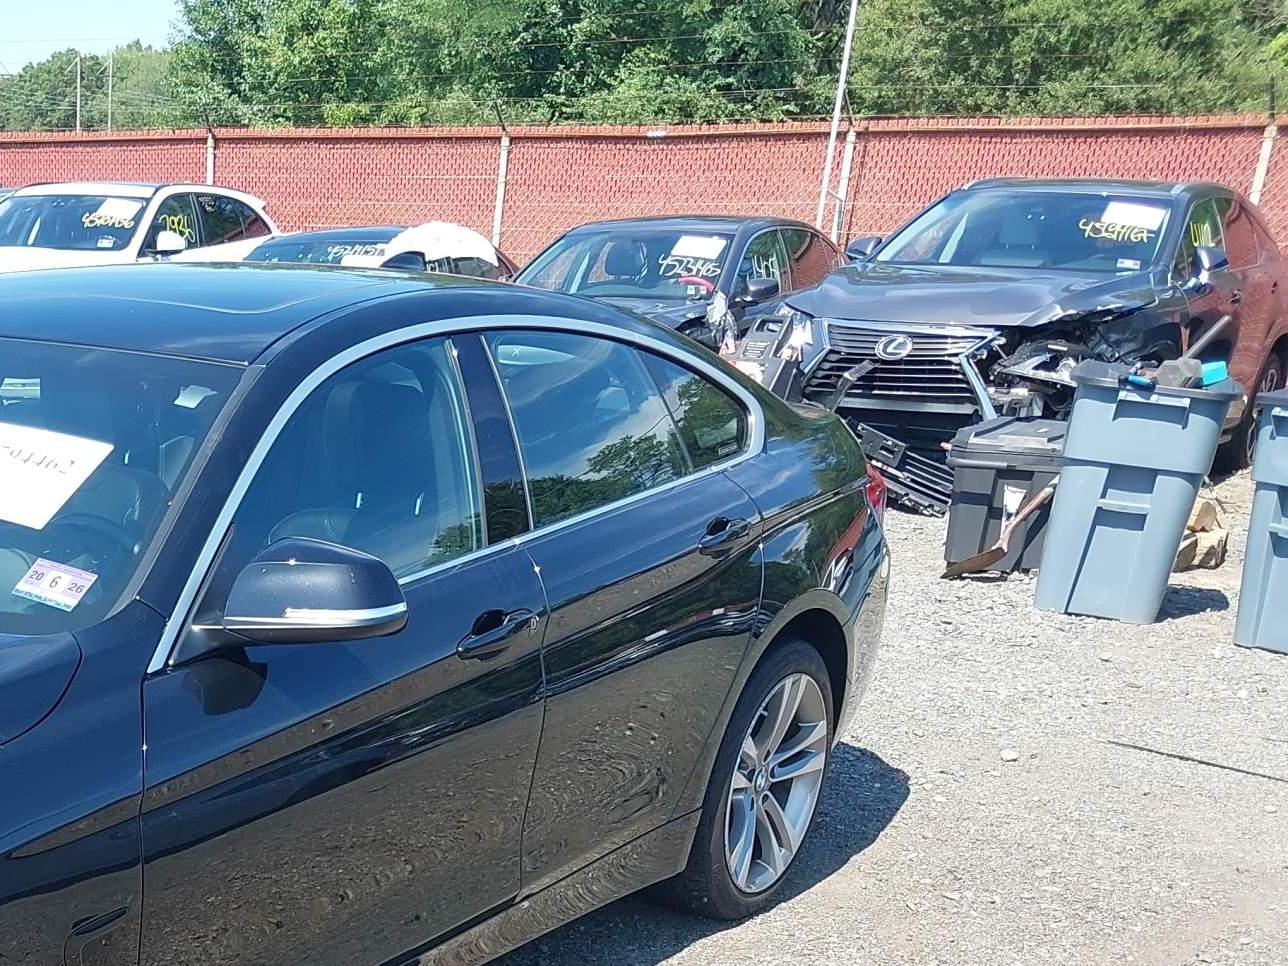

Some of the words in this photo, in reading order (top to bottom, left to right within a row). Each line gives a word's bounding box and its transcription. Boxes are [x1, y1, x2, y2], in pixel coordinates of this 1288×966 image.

[29, 570, 45, 581] 20
[49, 575, 62, 589] 6
[67, 582, 86, 594] 26
